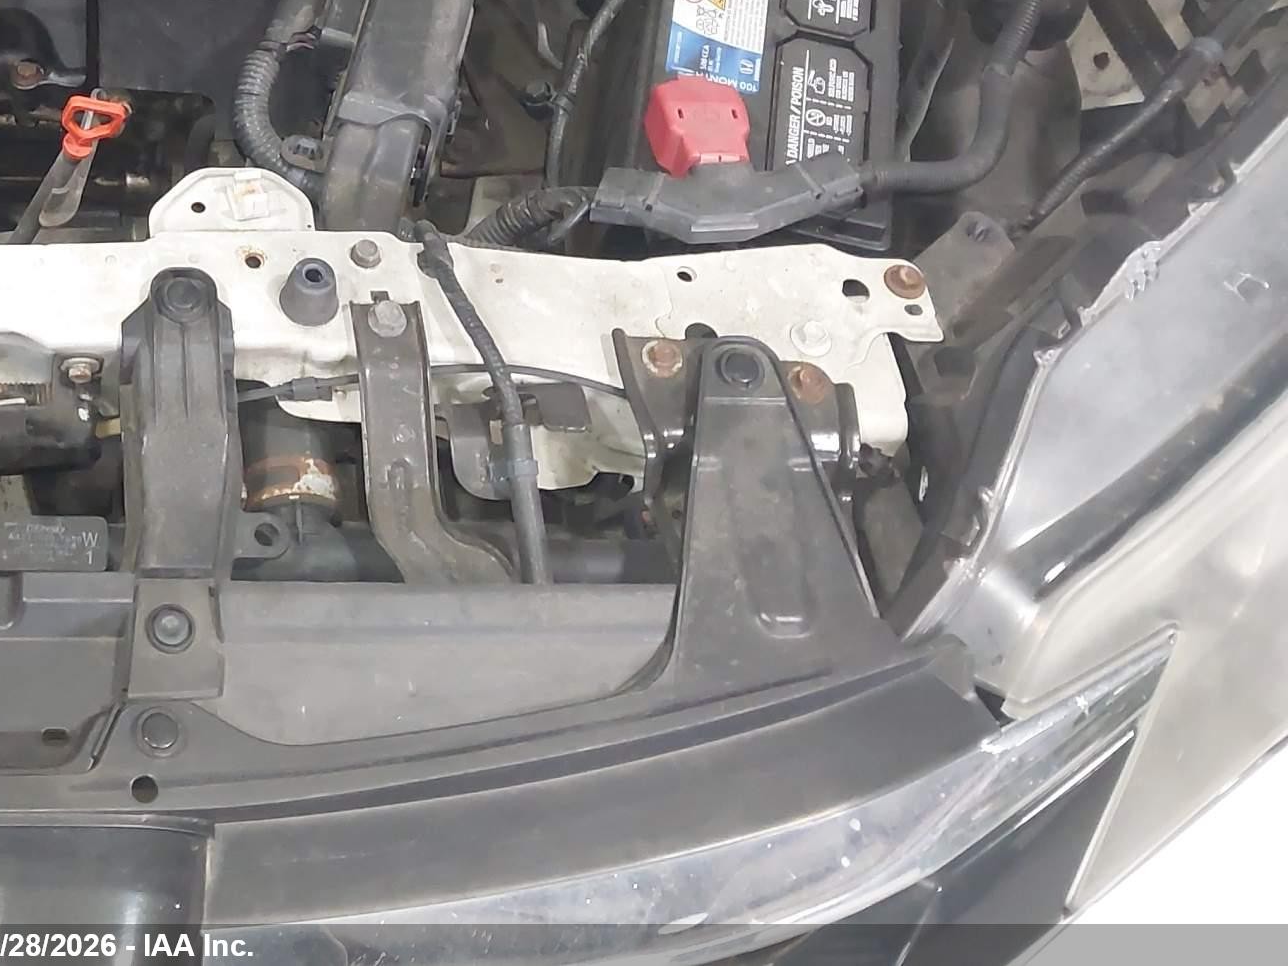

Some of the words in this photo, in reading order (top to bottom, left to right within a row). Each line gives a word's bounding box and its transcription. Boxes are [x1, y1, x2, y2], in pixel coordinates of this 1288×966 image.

[739, 82, 759, 92] 100
[82, 532, 98, 547] W
[86, 551, 93, 565] 1
